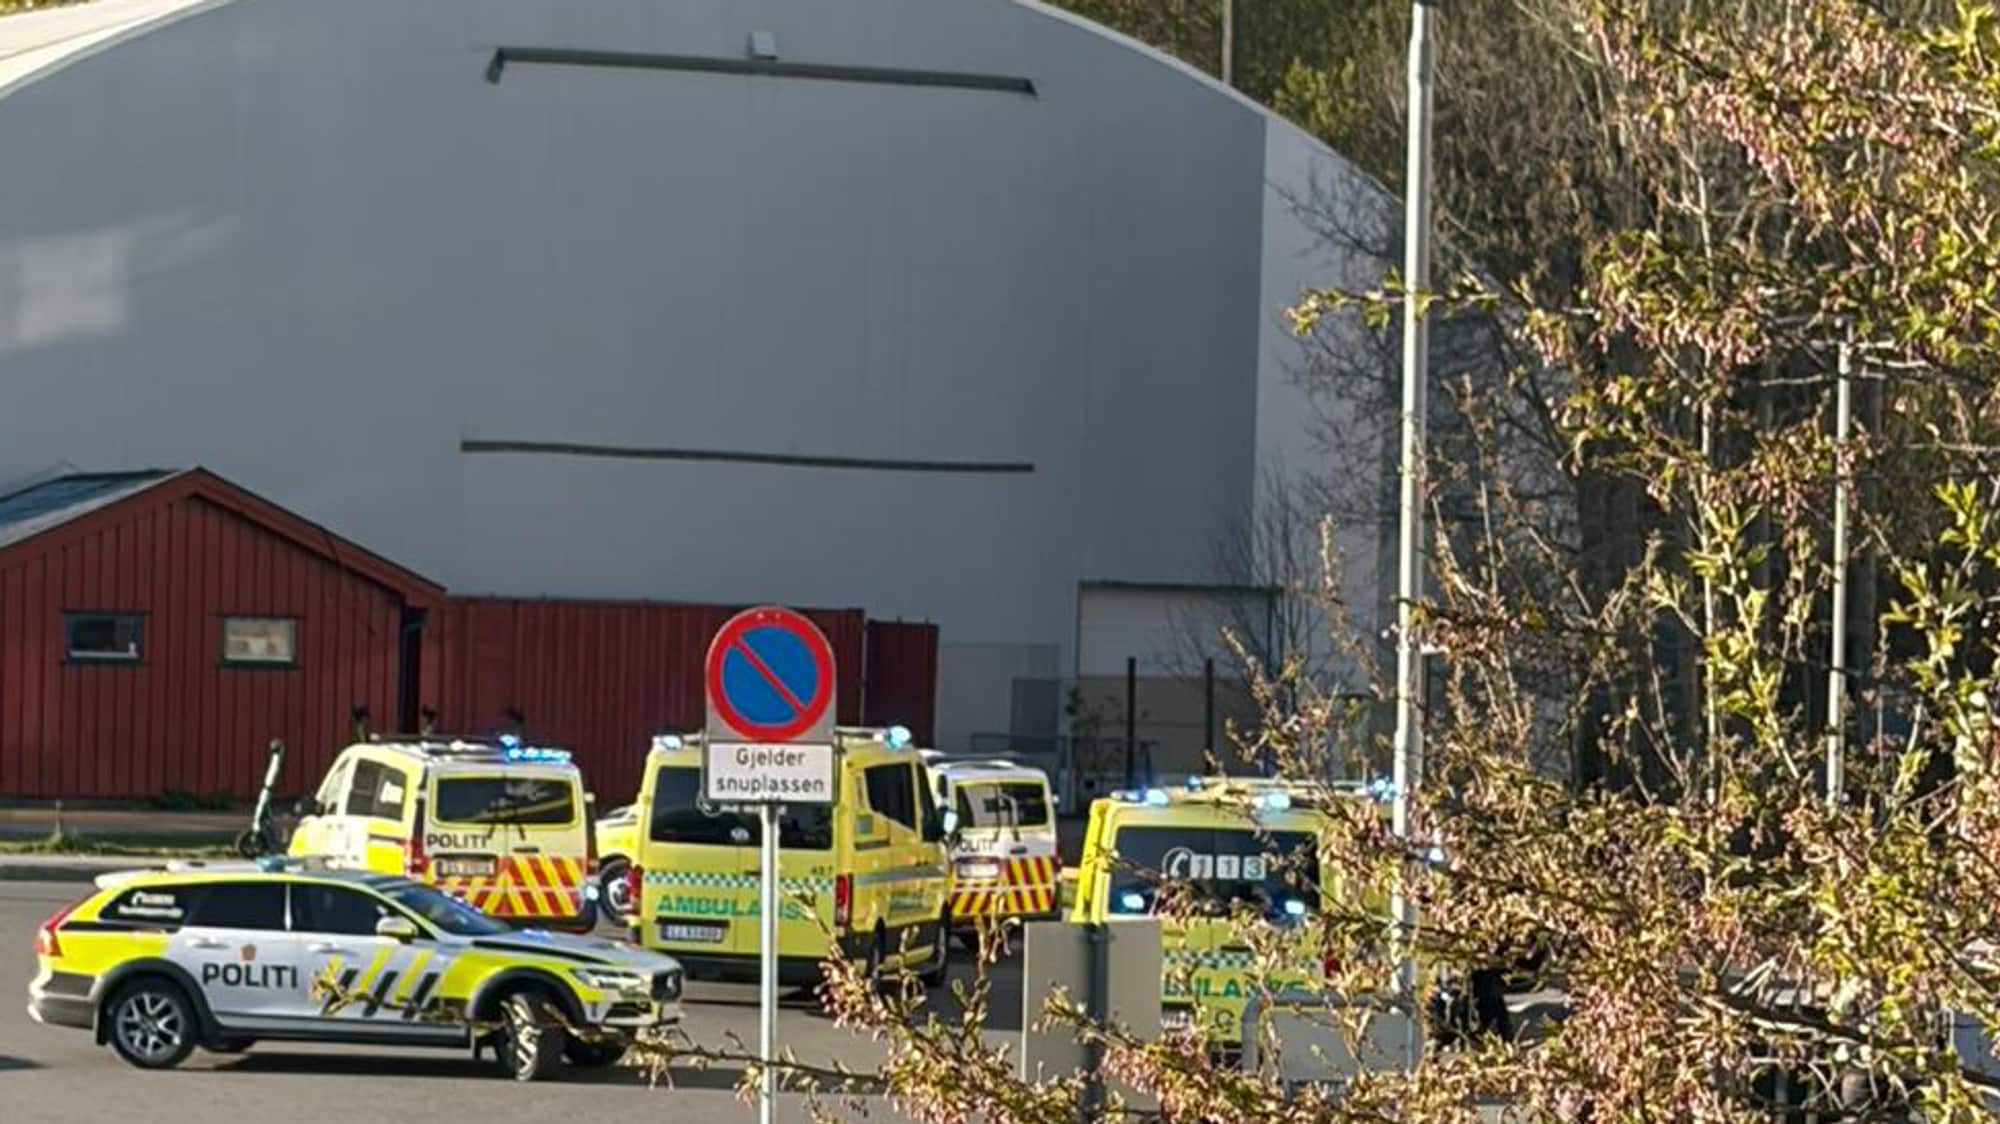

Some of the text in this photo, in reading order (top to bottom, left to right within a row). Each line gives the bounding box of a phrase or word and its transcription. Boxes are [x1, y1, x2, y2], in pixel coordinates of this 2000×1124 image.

[736, 747, 806, 769] Gjelder
[716, 774, 825, 794] snuplassen
[426, 833, 487, 848] POLITI
[202, 962, 298, 989] POLITI
